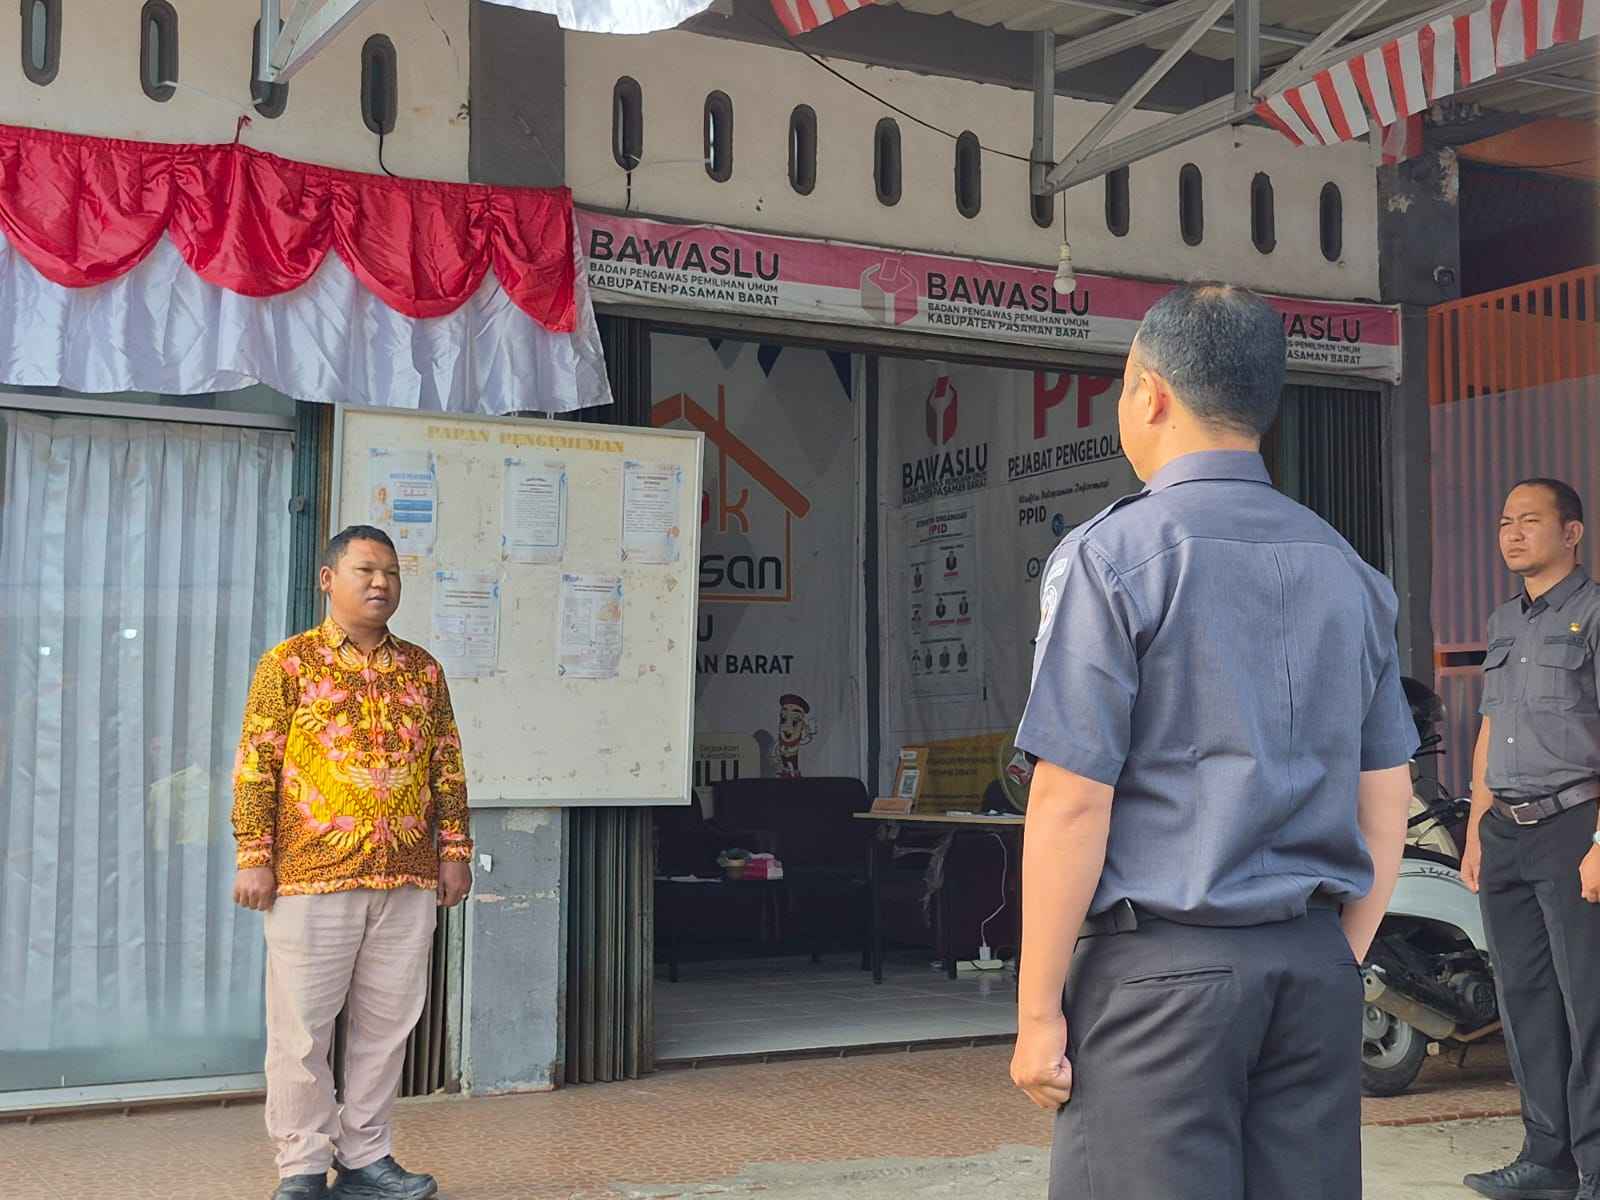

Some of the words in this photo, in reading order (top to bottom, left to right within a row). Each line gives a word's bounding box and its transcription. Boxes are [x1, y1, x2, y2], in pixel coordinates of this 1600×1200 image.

[590, 229, 779, 281] BAWASLU
[588, 274, 667, 294] KABUPATEN
[671, 284, 735, 301] PASAMAN
[738, 293, 779, 306] BARAT
[590, 262, 627, 276] BADAN
[630, 267, 688, 283] PENGAWAS
[691, 275, 745, 290] PEMILIHAN
[747, 283, 778, 294] UMUM
[927, 272, 1089, 316] BAWASLU
[928, 303, 960, 314] BADAN
[962, 307, 1012, 321] PENGAWAS
[1014, 313, 1061, 325] PEMILIHAN
[1063, 318, 1089, 327] UMUM
[928, 313, 996, 329] KABUPATEN
[999, 322, 1052, 336] PASAMAN
[1055, 327, 1090, 339] BARAT
[1282, 312, 1360, 343] ASLU
[1296, 341, 1335, 352] PEMILIHAN
[1338, 345, 1360, 353] UMUM
[1331, 354, 1360, 365] BARAT
[427, 425, 490, 442] PAPAN
[902, 443, 987, 489] BAWASLU
[1008, 448, 1053, 478] PEJABAT
[1019, 505, 1046, 526] PPID
[726, 654, 794, 674] BARAT
